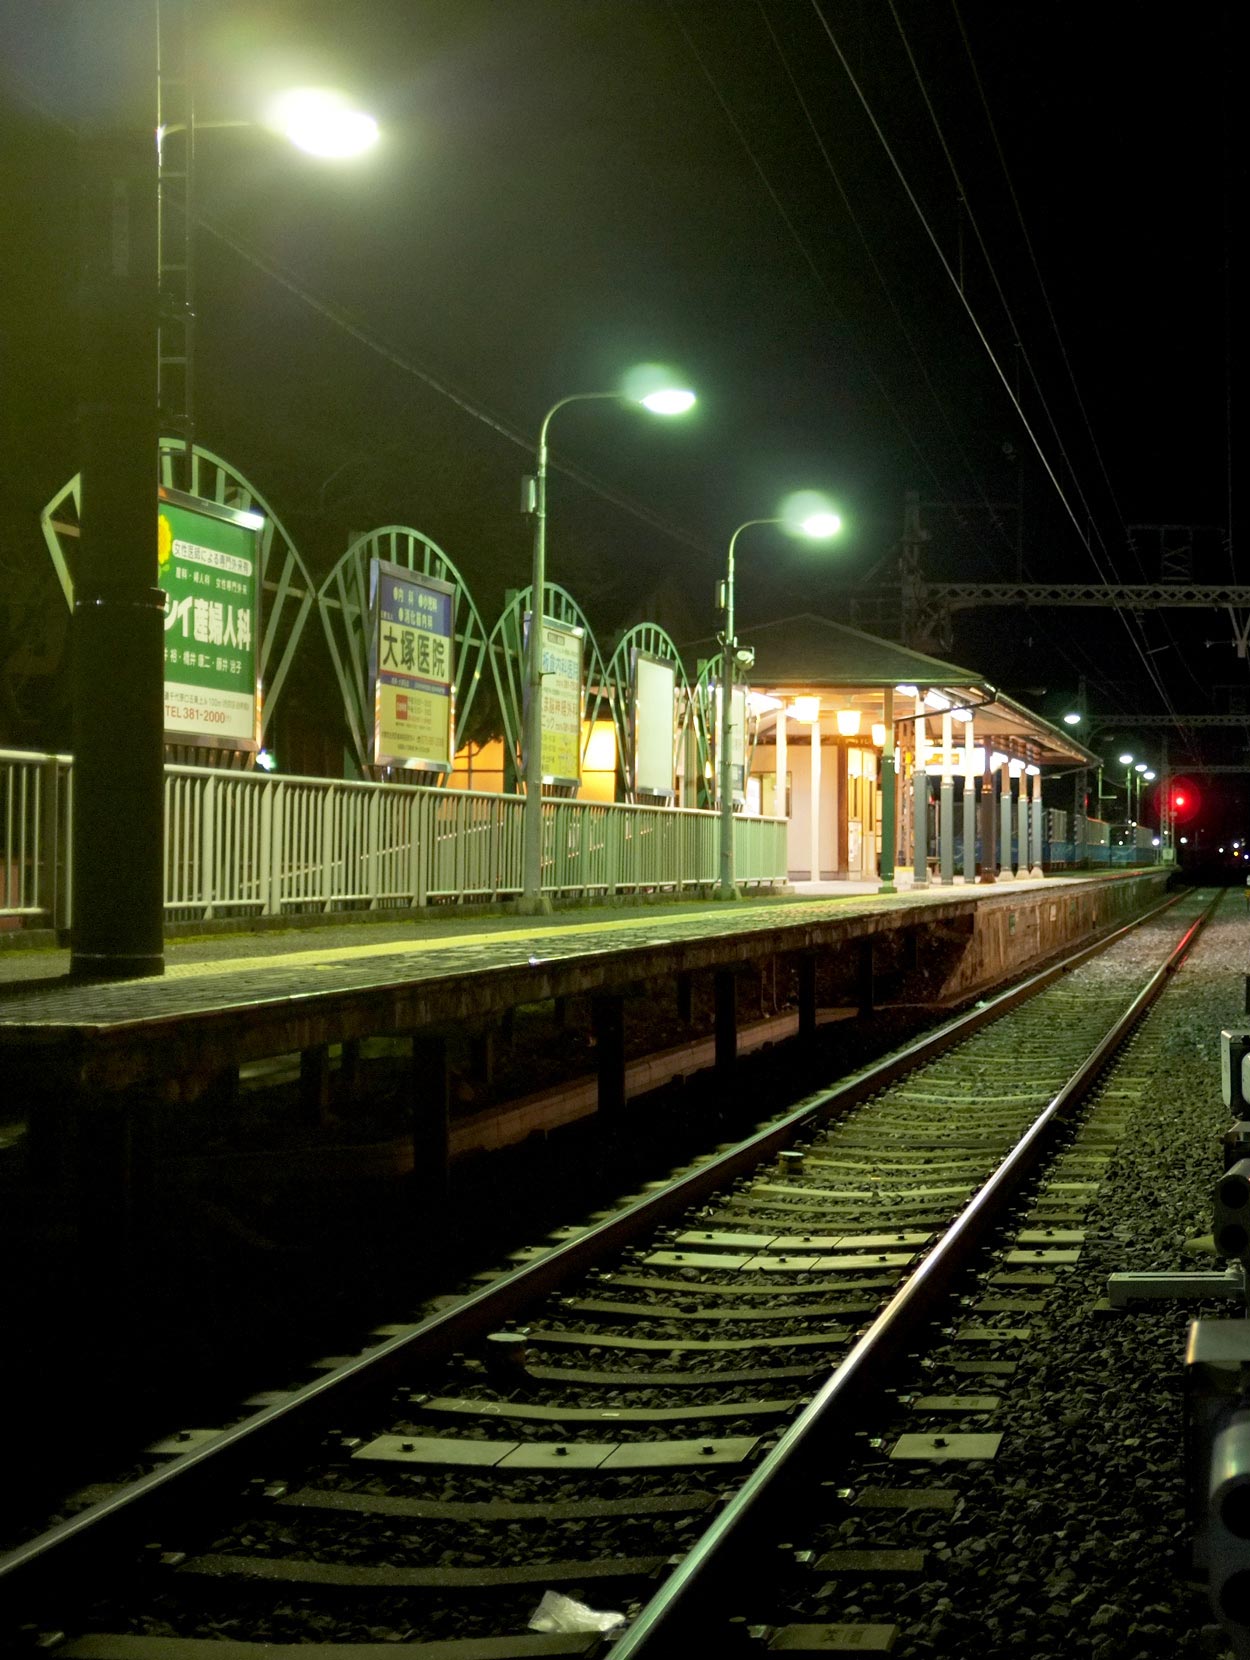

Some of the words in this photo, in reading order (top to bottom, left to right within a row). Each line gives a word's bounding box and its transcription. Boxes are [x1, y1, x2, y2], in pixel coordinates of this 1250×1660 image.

[383, 626, 445, 678] 大塚医院
[165, 705, 182, 718] TEL
[183, 707, 225, 723] 381-2000
